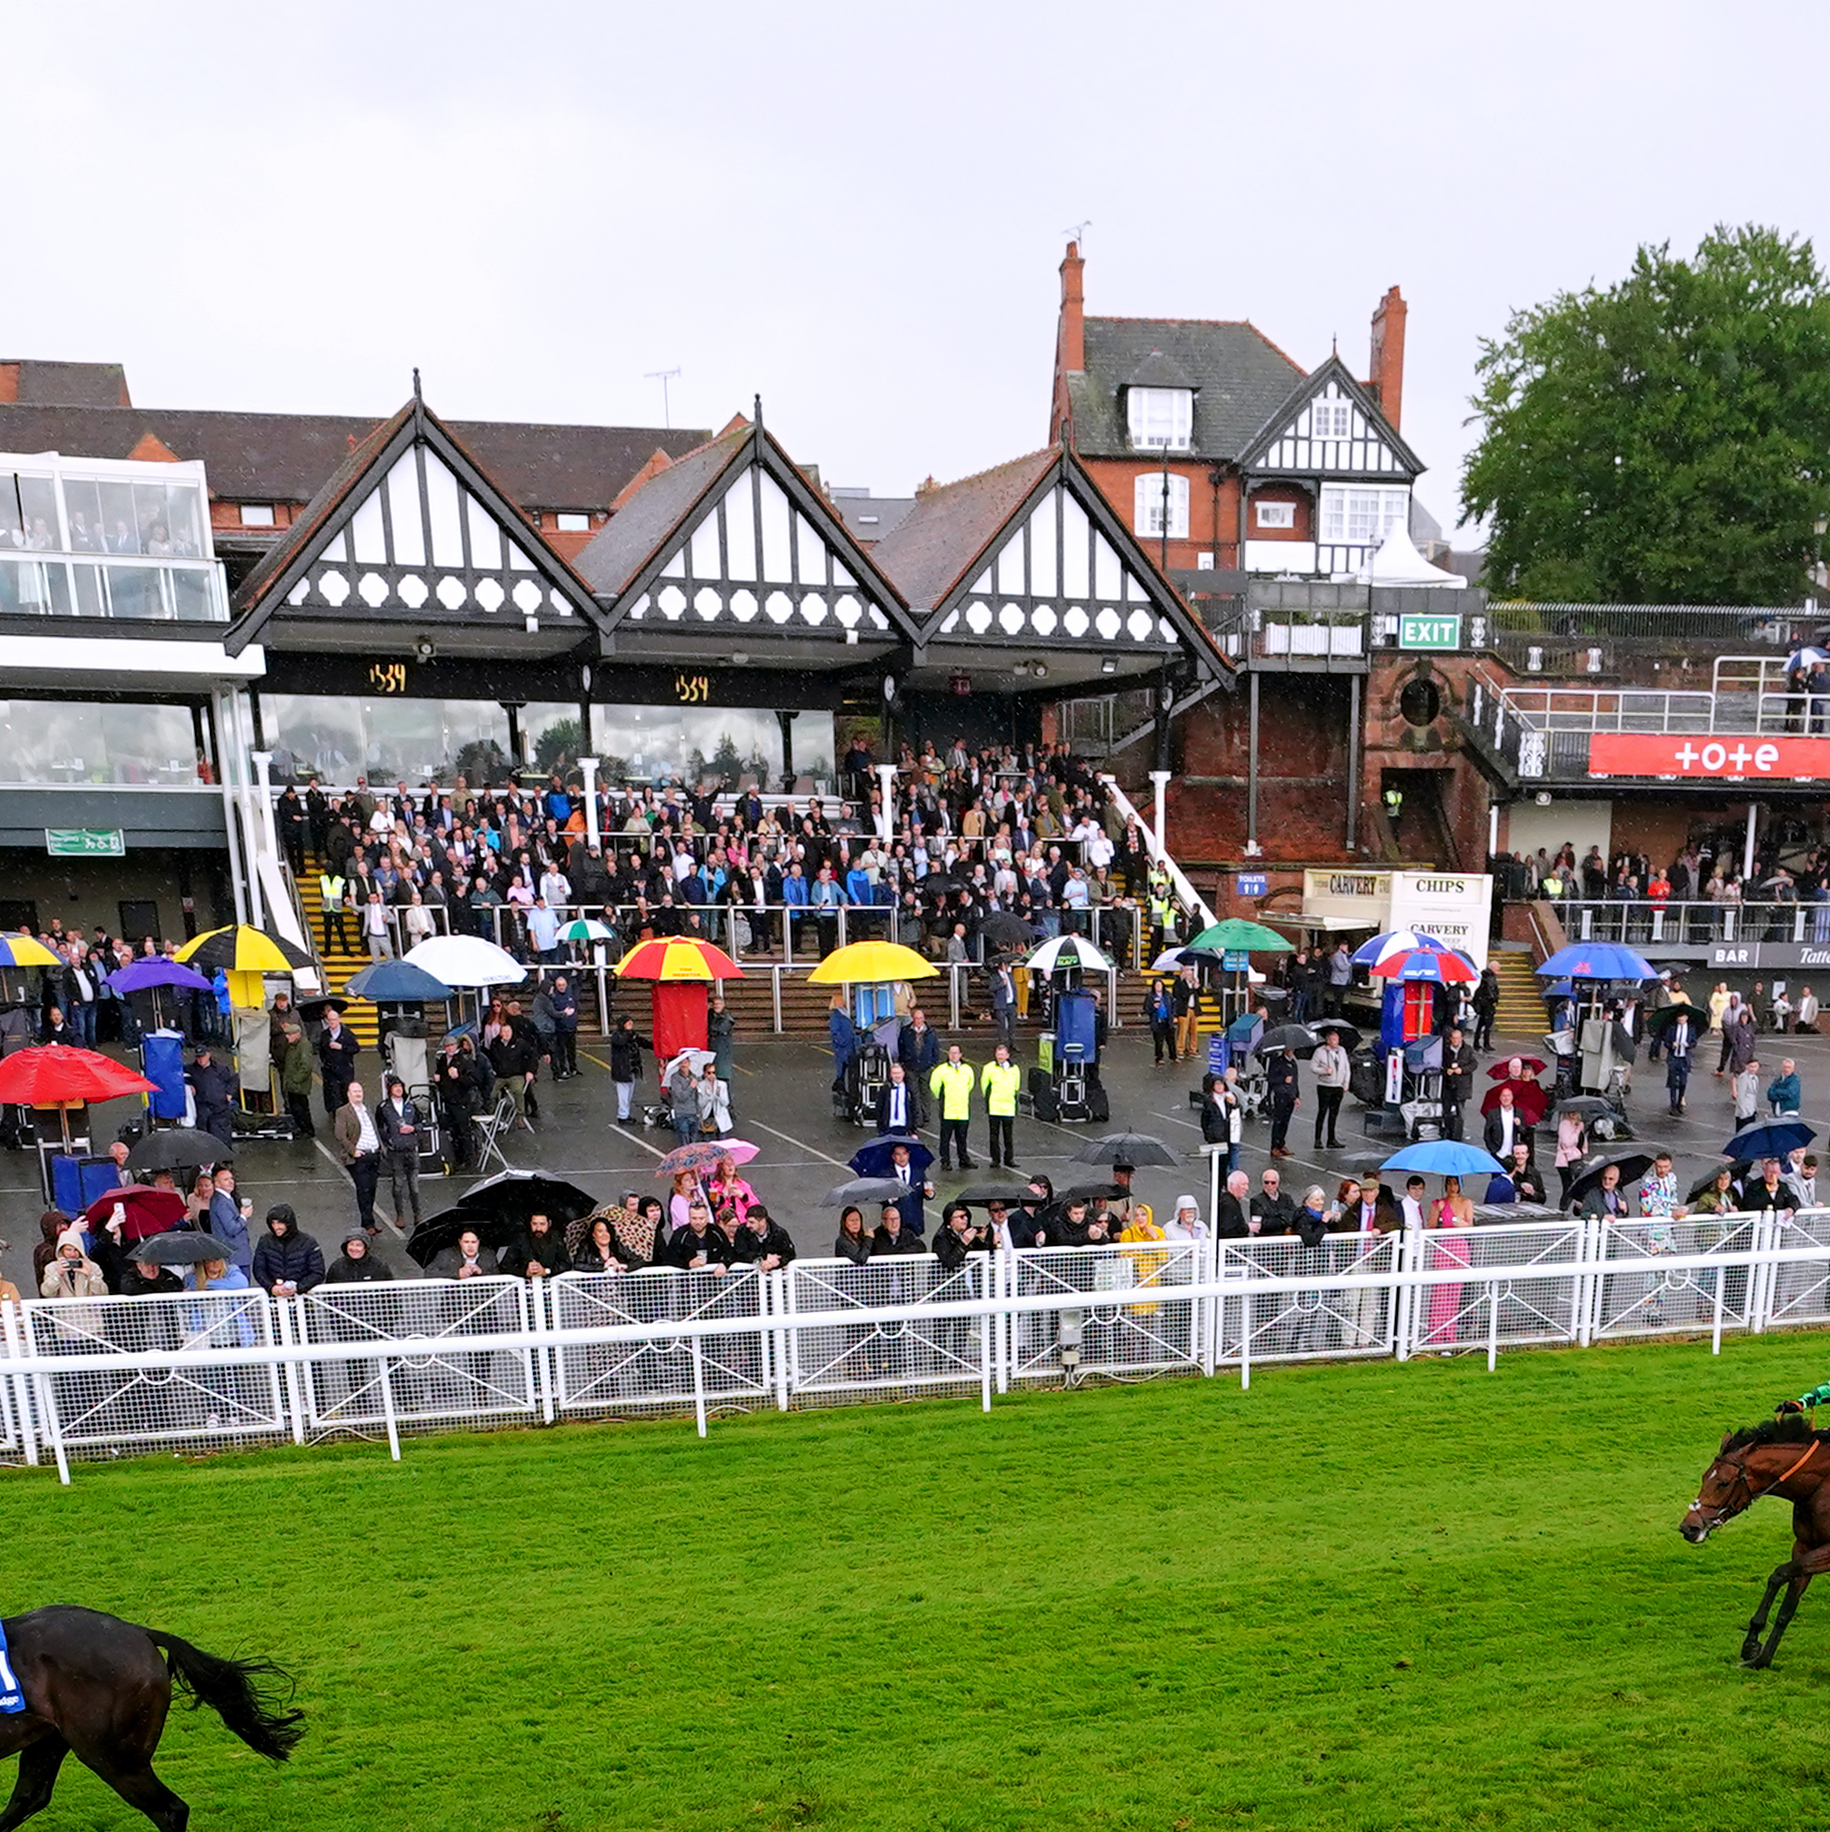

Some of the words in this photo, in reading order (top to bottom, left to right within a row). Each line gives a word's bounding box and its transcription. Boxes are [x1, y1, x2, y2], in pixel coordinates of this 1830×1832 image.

[1404, 621, 1454, 642] EXIT
[1238, 874, 1266, 883] TOILETS
[1329, 874, 1377, 895] CARVERY
[1415, 879, 1465, 893] CHIPS
[1410, 923, 1469, 936] CARVERY
[1714, 949, 1749, 963] BAR
